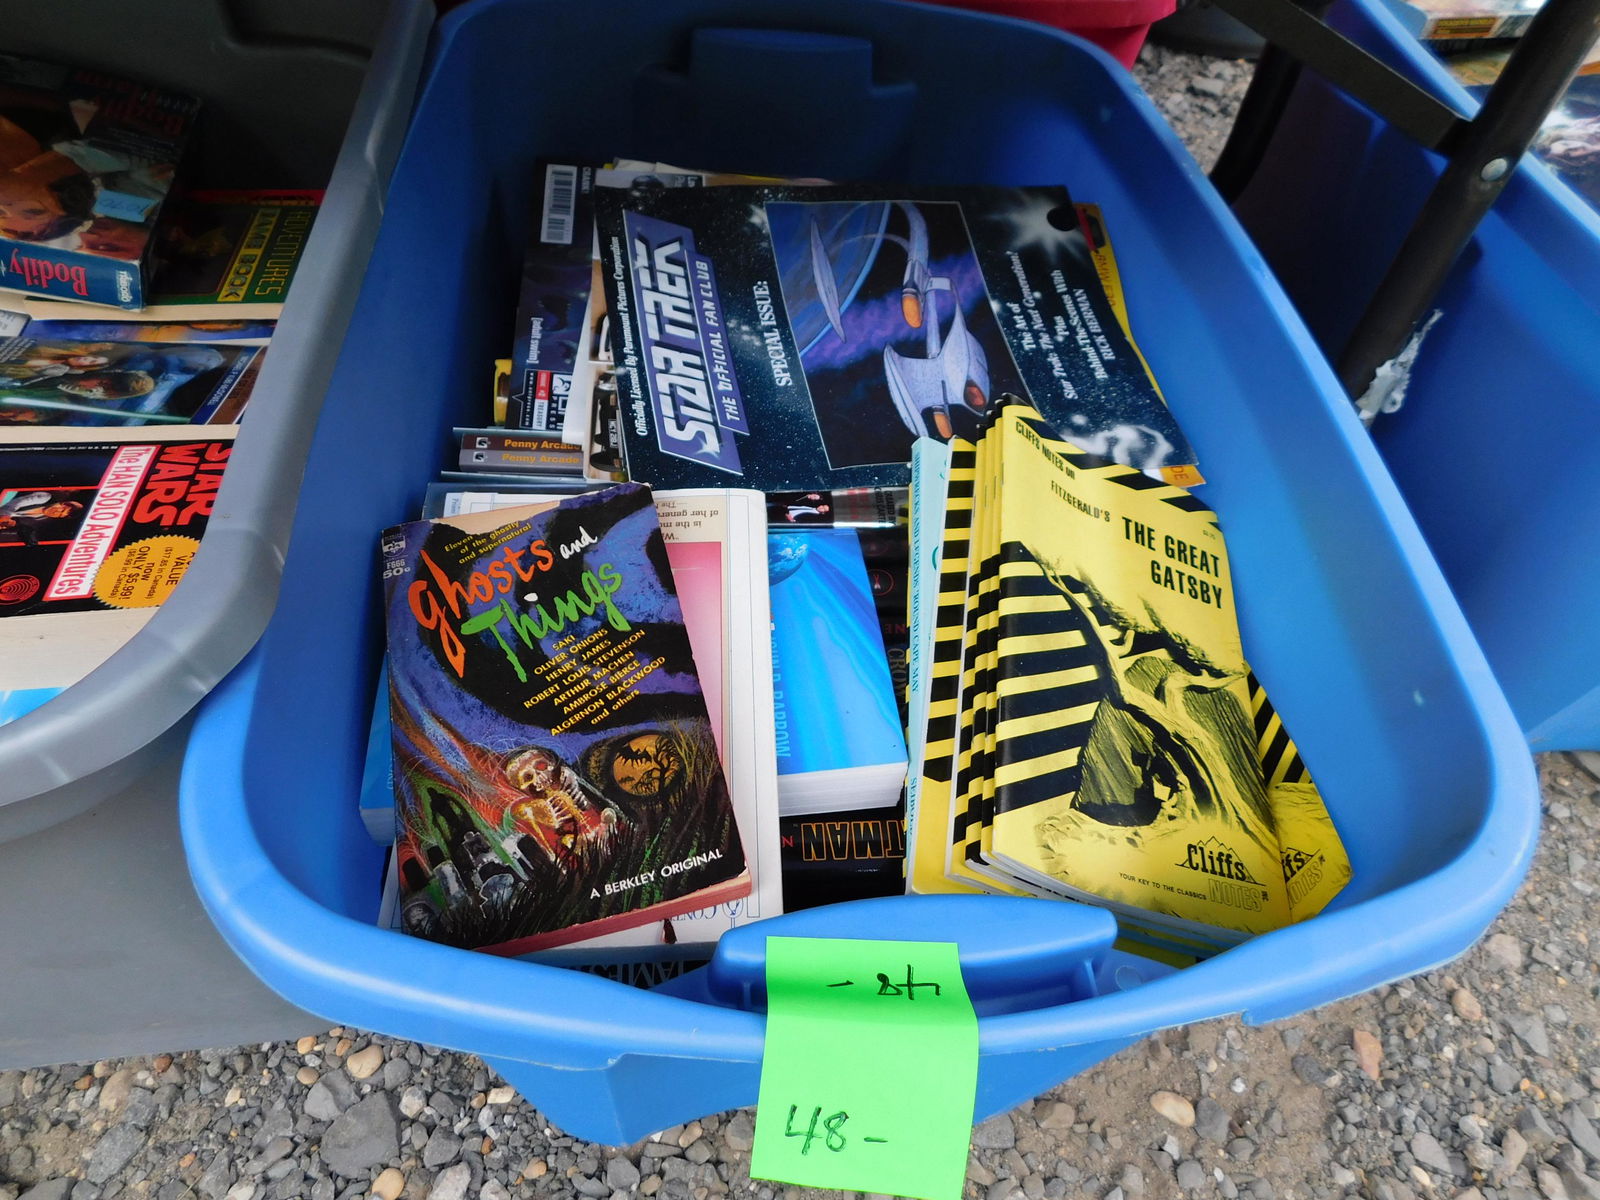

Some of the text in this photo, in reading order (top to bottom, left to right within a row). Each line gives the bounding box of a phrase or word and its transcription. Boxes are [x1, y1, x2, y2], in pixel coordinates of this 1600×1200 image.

[10, 248, 89, 297] Bodily
[611, 236, 625, 280] Corporation
[616, 280, 629, 312] Pictures
[1073, 289, 1102, 334] BERMAN
[618, 312, 635, 353] Paramount
[695, 260, 740, 421] THE OFFICIAL FAN CLUB
[753, 280, 793, 387] SPECIAL ISSUE:
[1006, 302, 1036, 351] The Art of
[1028, 309, 1046, 332] Next
[1038, 332, 1055, 350] The
[634, 238, 720, 454] STAR TREK
[1093, 335, 1116, 361] RICK
[627, 366, 643, 400] Licensed
[1060, 379, 1078, 400] Star
[629, 400, 648, 437] Officially
[502, 453, 580, 465] Penny Arcade
[504, 439, 538, 450] Penny
[1015, 422, 1040, 450] CLIFFS
[1040, 443, 1065, 473] NOTES
[133, 444, 202, 527] WARS
[1050, 480, 1111, 523] FITZGERALD'S
[55, 446, 157, 596] The HAN SOLO Adventures
[690, 510, 707, 518] her
[709, 509, 719, 518] of
[131, 545, 151, 571] ONLY
[445, 535, 474, 552] Eleven
[459, 523, 532, 564] and supernatural
[559, 526, 598, 560] and
[1122, 516, 1221, 579] THE GREAT
[140, 562, 155, 582] now
[165, 555, 188, 586] VALUE
[1150, 560, 1223, 609] GATSBY
[460, 563, 632, 682] Things
[552, 634, 576, 651] SAKI
[524, 629, 645, 709] ROBERT LOUIS STEVENSON
[534, 629, 608, 675] OLIVER ONIONS
[545, 639, 611, 682] HENRY JAMES
[912, 634, 920, 665] CAPE
[550, 656, 665, 736] ALGERNON BLACKWOOD
[553, 650, 634, 706] ARTHUR MACHEN
[563, 660, 640, 715] AMBROSE BIERCE
[591, 689, 640, 725] and others
[802, 819, 906, 862] TMAN
[589, 848, 723, 899] A BERKLEY ORIGINAL
[1187, 844, 1247, 881] Cliffs
[1119, 872, 1207, 901] YOUR KEY TO THE CLASSICS
[1208, 878, 1262, 913] NOTES
[1288, 861, 1323, 908] OTES
[785, 1104, 850, 1156] 48
